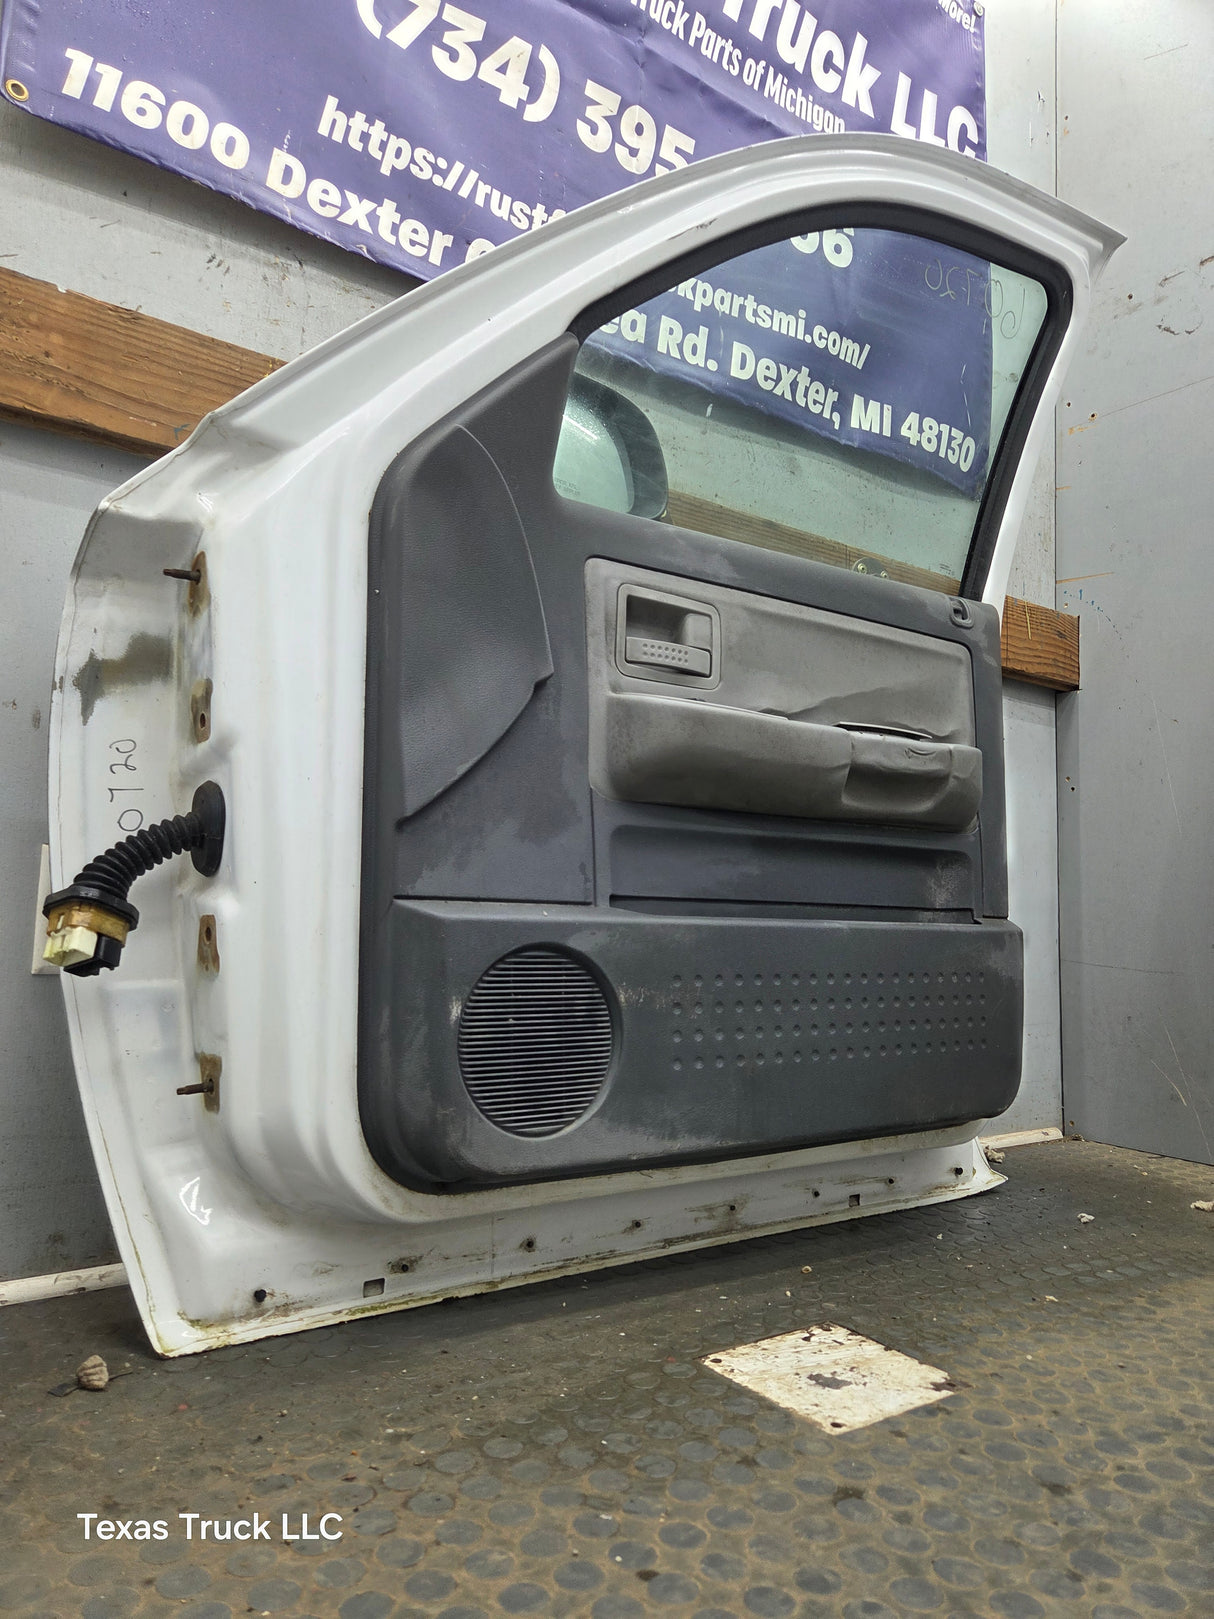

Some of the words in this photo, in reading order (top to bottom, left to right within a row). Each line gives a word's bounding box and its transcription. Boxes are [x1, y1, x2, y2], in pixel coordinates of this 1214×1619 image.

[630, 0, 690, 41] uck
[688, 11, 742, 76] Parts
[742, 58, 767, 91] of
[764, 66, 846, 133] Michigan
[890, 71, 979, 158] LLC
[576, 78, 696, 177] 395
[61, 48, 250, 170] 11600
[265, 147, 454, 267] Dexter
[657, 315, 718, 372] Rd.
[730, 341, 841, 430] Dexter,
[851, 393, 892, 437] MI
[901, 411, 976, 473] 48130
[668, 277, 871, 370] kpartsmi.com/
